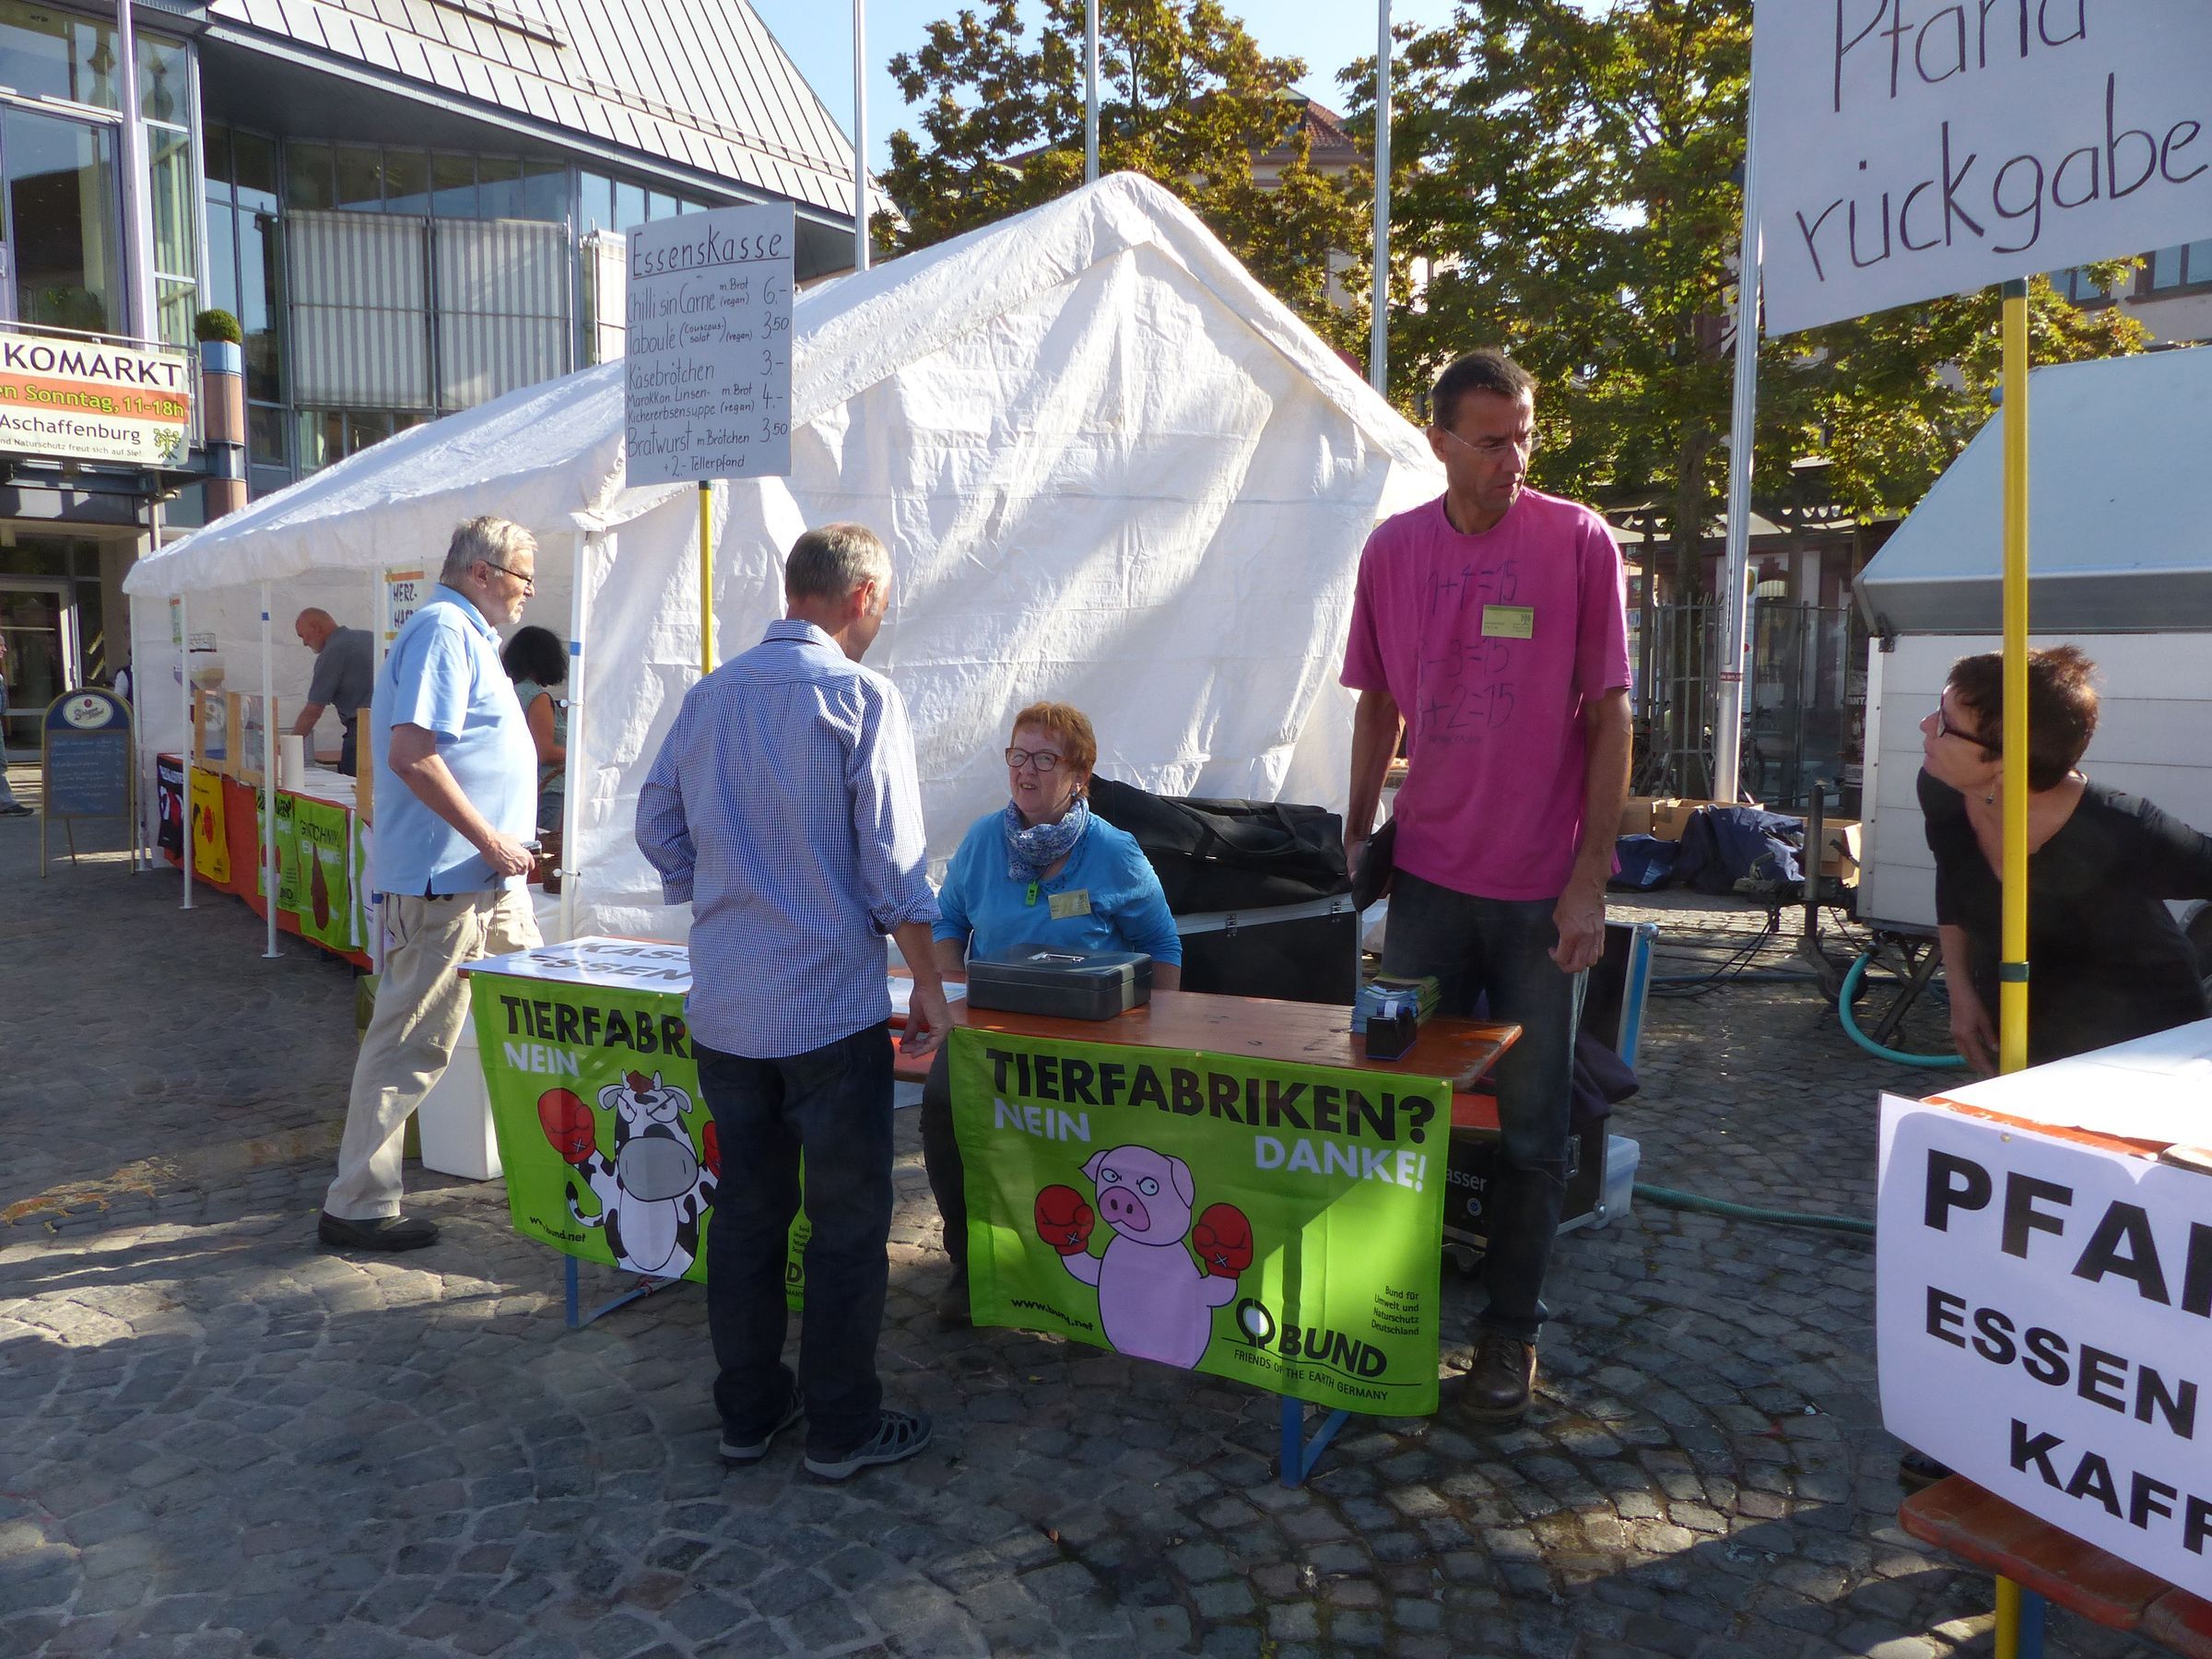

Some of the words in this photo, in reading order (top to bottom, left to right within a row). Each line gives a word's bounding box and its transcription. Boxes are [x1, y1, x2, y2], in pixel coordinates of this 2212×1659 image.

[1795, 72, 2209, 282] rückgabe
[679, 282, 715, 314] Carne
[629, 358, 715, 391] Käsebrötchen
[25, 384, 120, 414] Sonntag,
[123, 397, 185, 418] 11-18h
[0, 414, 141, 444] Aschaffenburg
[627, 420, 693, 458] Bratwurst
[68, 443, 89, 453] freut
[690, 454, 746, 472] Tellerpfand
[503, 1041, 582, 1077] NEIN
[985, 1048, 1435, 1144] TIERFABRIKEN?
[994, 1098, 1091, 1142] NEIN
[1254, 1135, 1428, 1192] DANKE!
[1374, 1294, 1400, 1312] Umwelt
[1402, 1302, 1419, 1312] und
[1385, 1286, 1404, 1300] Bund
[1406, 1290, 1419, 1300] für
[1371, 1319, 1419, 1335] Deutschland
[1372, 1307, 1419, 1324] Naturschutz
[1278, 1323, 1388, 1377] BUND
[1925, 1284, 2199, 1441] ESSEN
[1234, 1348, 1271, 1370] FRIENDS
[1285, 1367, 1305, 1380] THE
[1336, 1382, 1389, 1401] GERMANY
